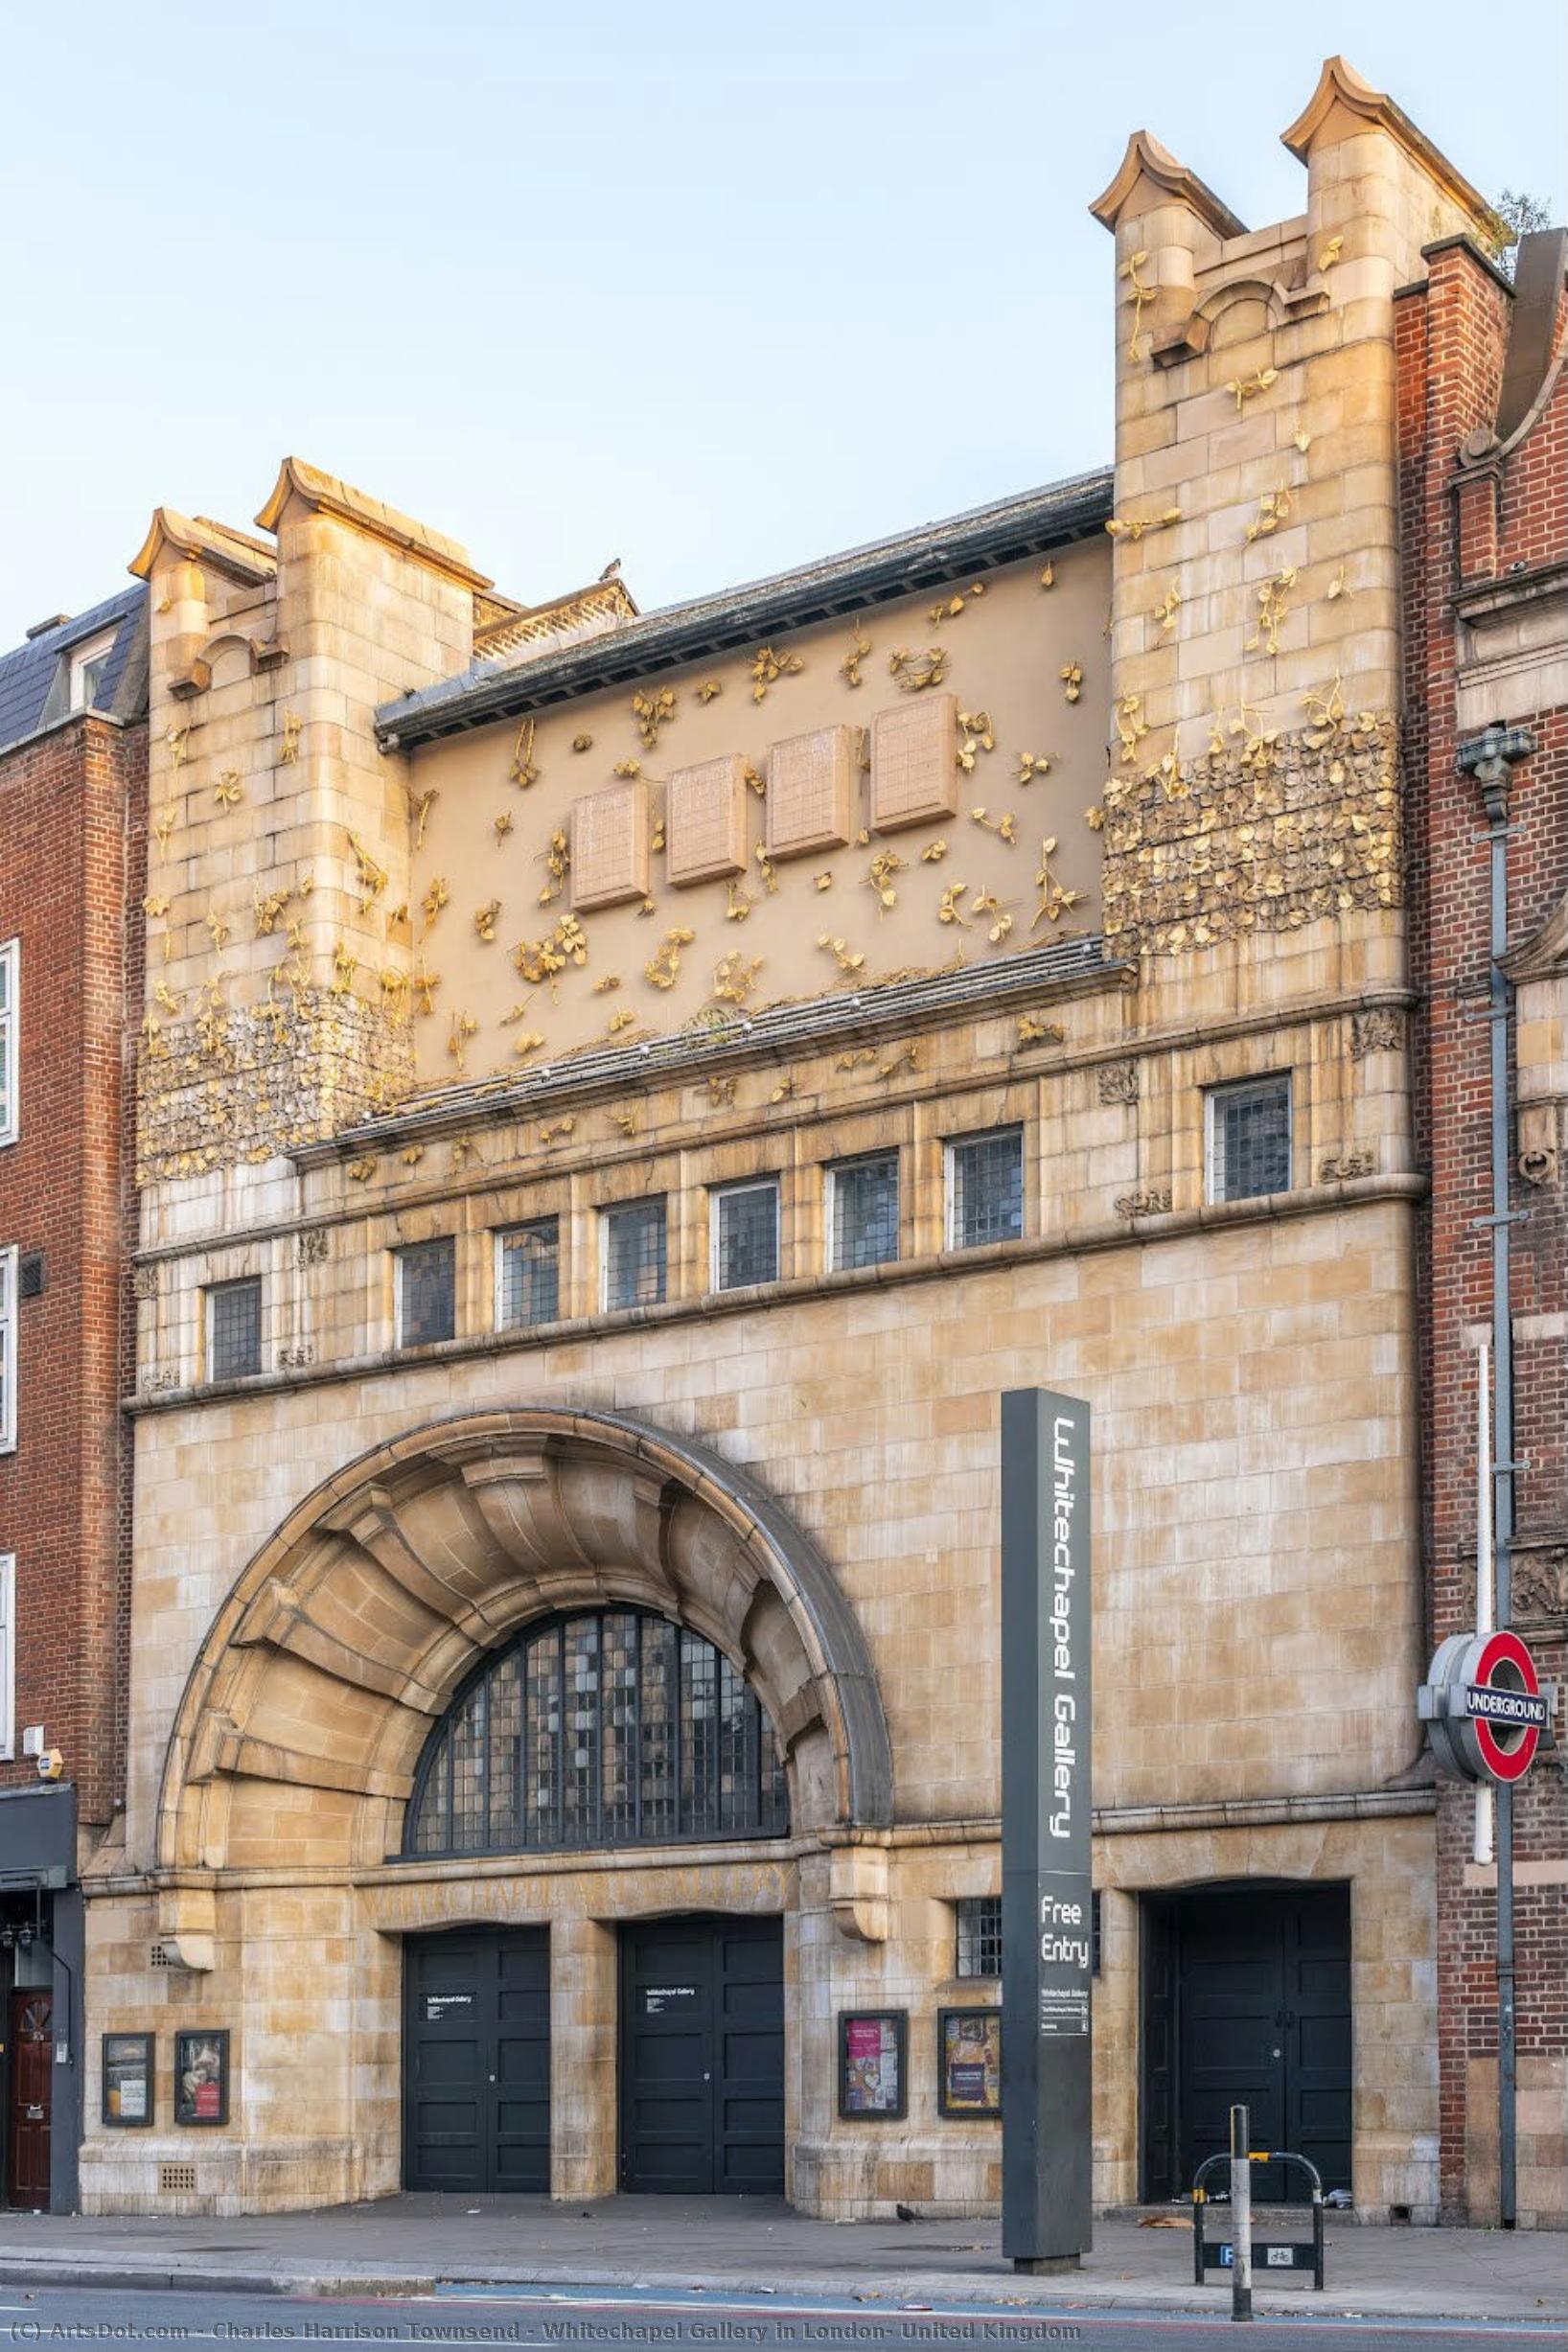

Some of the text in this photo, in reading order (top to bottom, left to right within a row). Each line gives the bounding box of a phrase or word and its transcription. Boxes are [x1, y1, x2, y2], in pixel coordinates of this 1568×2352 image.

[1049, 1417, 1075, 1838] Whitechapel Gallery
[1466, 1691, 1545, 1720] UNDERGROUND
[1041, 1895, 1081, 1925] Free
[1041, 1933, 1089, 1969] Entry
